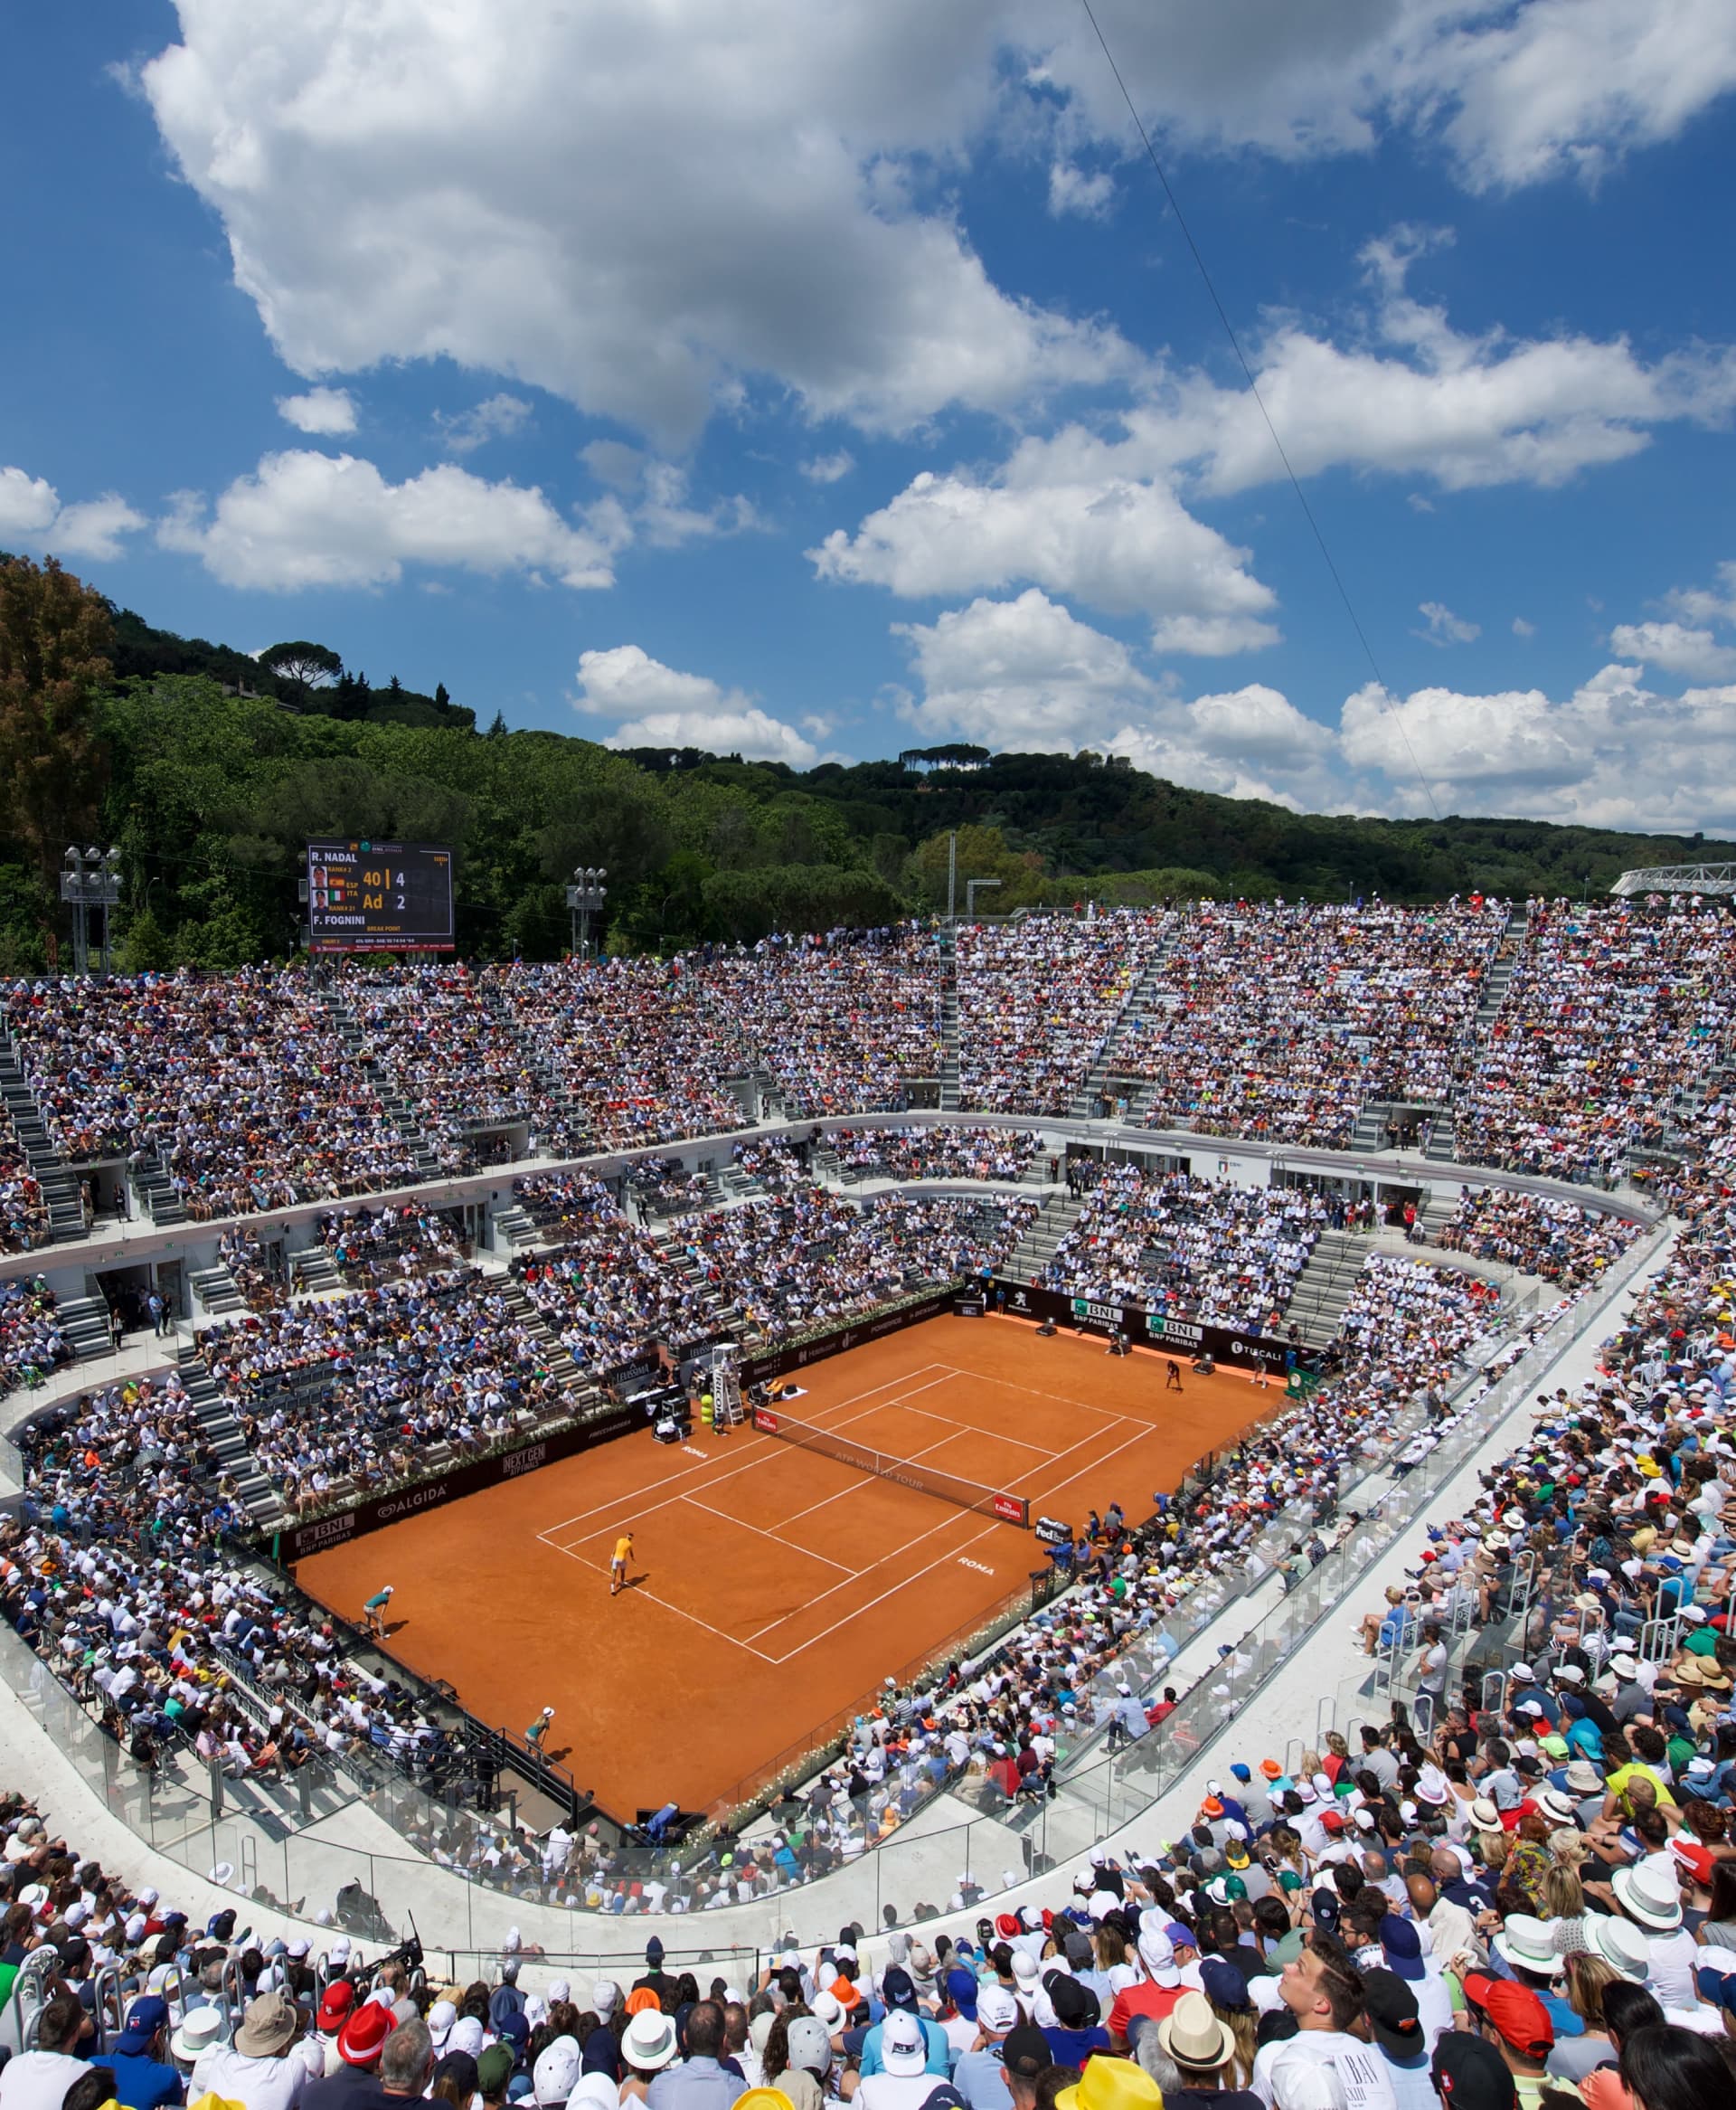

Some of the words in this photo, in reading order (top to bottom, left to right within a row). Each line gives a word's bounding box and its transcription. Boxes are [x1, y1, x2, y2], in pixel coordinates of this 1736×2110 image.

[312, 852, 323, 862] R.
[325, 853, 358, 863] NADAL
[363, 872, 382, 886] 40
[396, 873, 405, 887] 4
[363, 893, 383, 910] Ad
[397, 894, 406, 910] 2
[314, 915, 323, 925] F.
[325, 915, 365, 925] FOGNINI
[1089, 1304, 1120, 1320] BNL
[1073, 1314, 1088, 1322] BNP
[1089, 1318, 1118, 1330] PARIBAS
[1165, 1320, 1199, 1339] BNL
[1148, 1330, 1165, 1340] BNP
[1165, 1334, 1198, 1349] PARIBAS
[505, 1451, 527, 1470] NEXT
[527, 1445, 544, 1462] GEN
[835, 1452, 854, 1462] ATP
[896, 1472, 924, 1490] TOUR
[396, 1484, 447, 1513] ALGIDA
[995, 1502, 1021, 1519] Emirates
[318, 1518, 351, 1538] BNL
[300, 1542, 317, 1556] BNP
[318, 1529, 352, 1549] PARIBAS
[957, 1556, 995, 1575] ROMA
[1514, 1589, 1527, 1601] 03
[1458, 1610, 1469, 1622] 02
